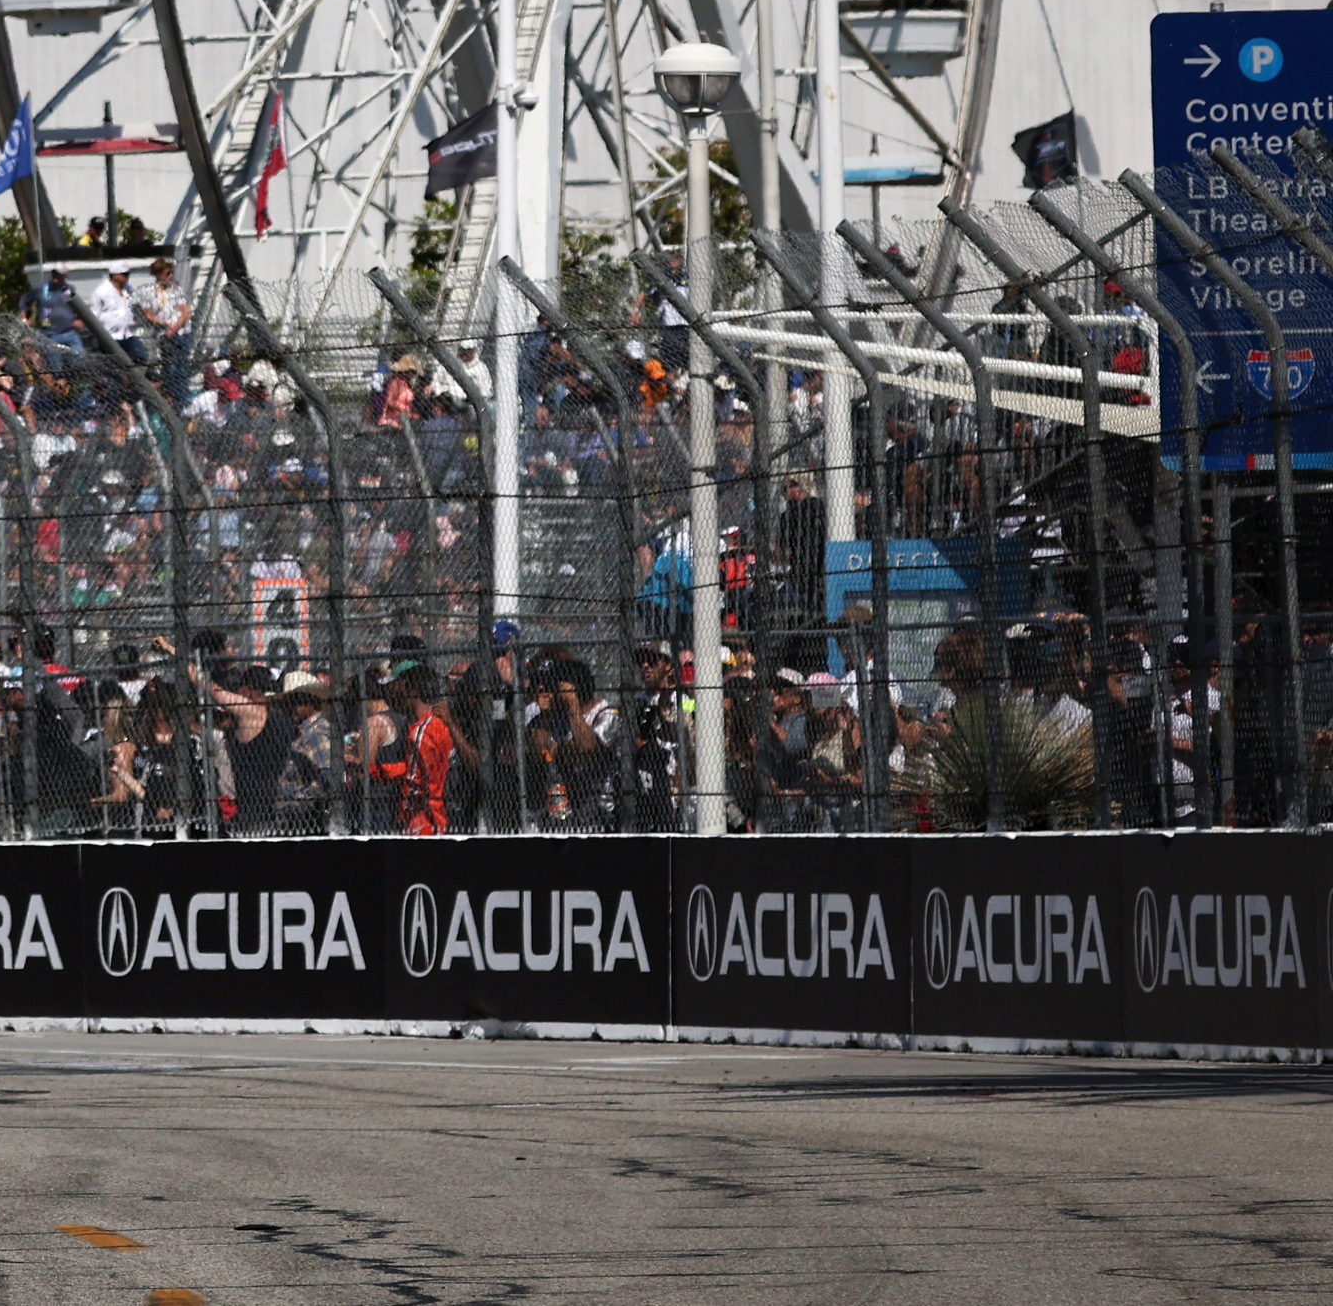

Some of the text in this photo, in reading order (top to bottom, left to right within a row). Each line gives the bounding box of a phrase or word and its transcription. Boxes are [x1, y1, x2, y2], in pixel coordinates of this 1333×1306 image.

[1251, 46, 1274, 74] P
[1185, 95, 1333, 123] Conventi
[1188, 175, 1229, 199] LB
[1188, 208, 1315, 233] Thear
[1189, 249, 1327, 278] Sorelin
[1190, 285, 1306, 312] Vilge
[1258, 366, 1303, 389] 70
[141, 891, 366, 971] ACURA
[440, 890, 650, 972] ACURA
[720, 891, 895, 980] ACURA
[954, 894, 1111, 984] ACURA
[1162, 894, 1306, 988] ACURA
